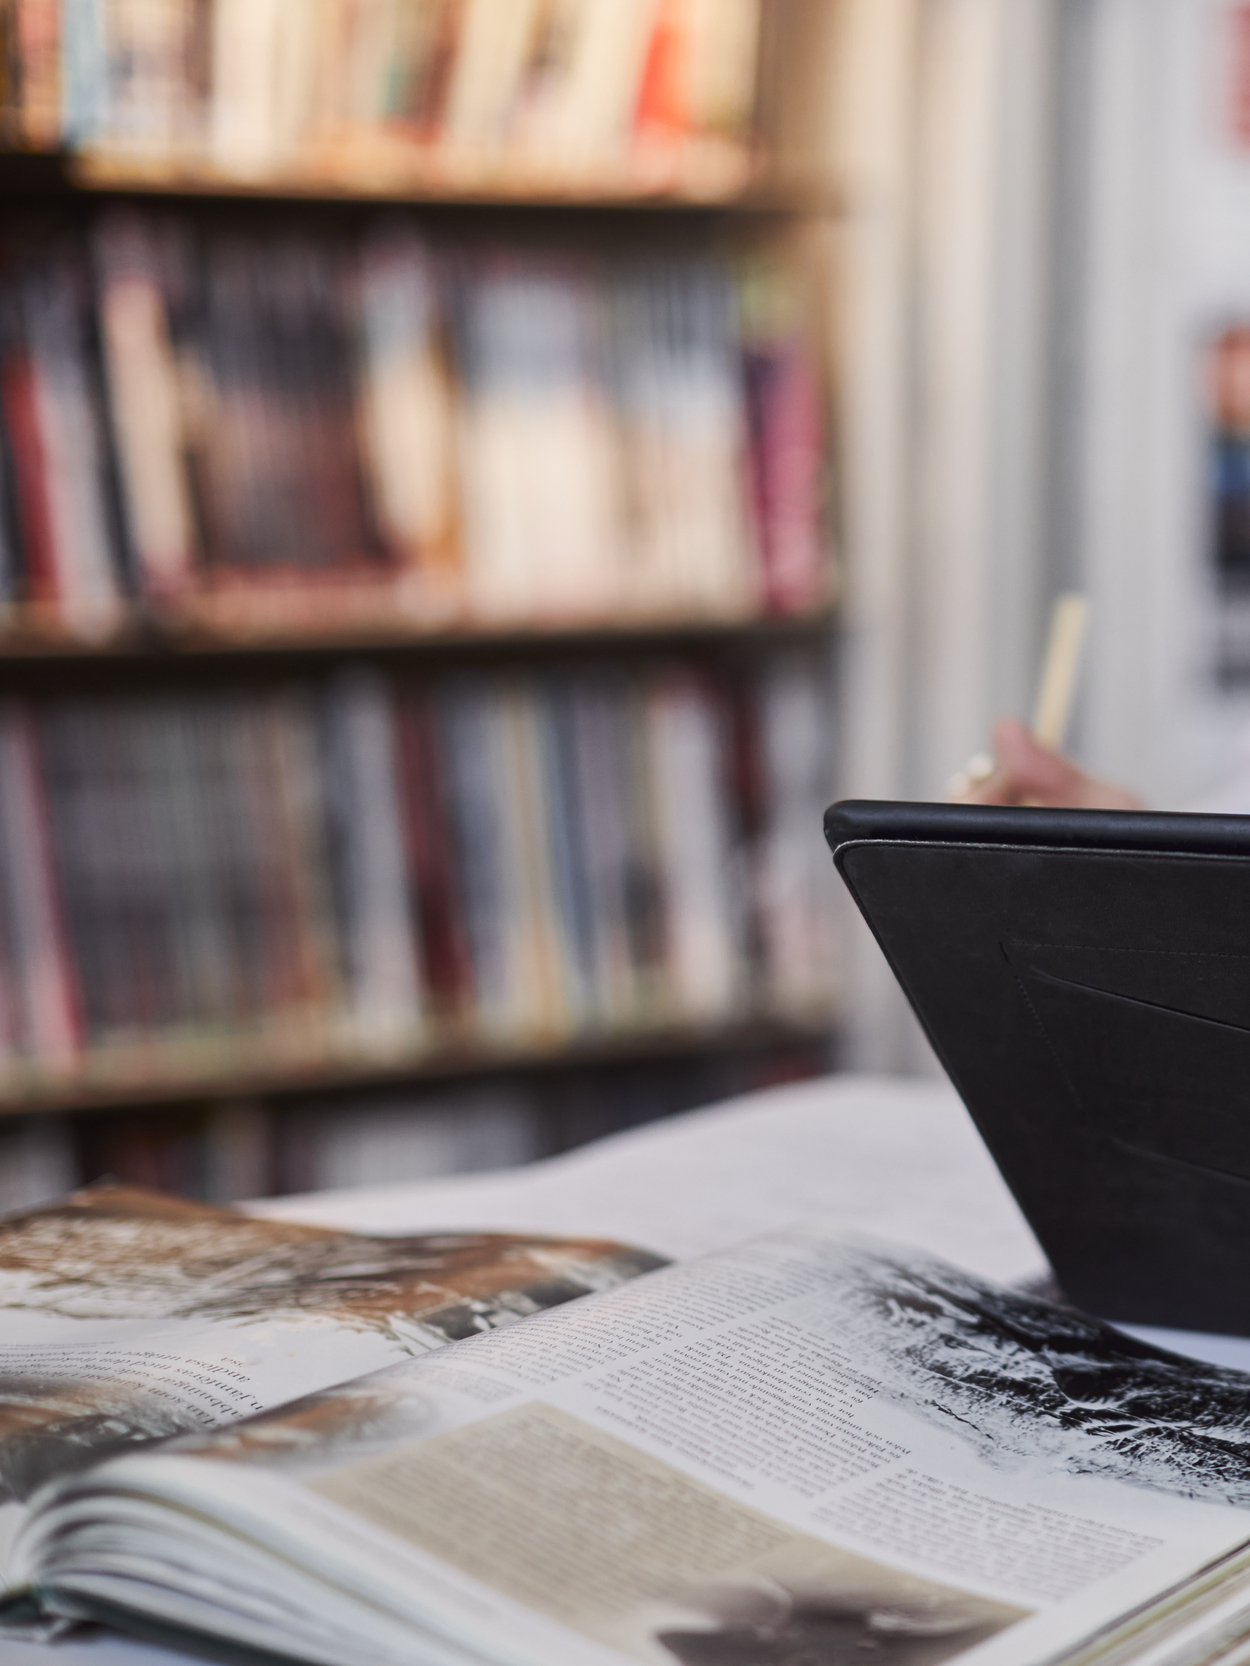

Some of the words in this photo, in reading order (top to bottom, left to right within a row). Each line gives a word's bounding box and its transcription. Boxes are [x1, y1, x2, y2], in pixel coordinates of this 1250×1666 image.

[716, 1333, 731, 1341] var
[727, 1329, 770, 1349] acceptera
[695, 1341, 713, 1351] han
[706, 1337, 736, 1352] styrkor
[731, 1340, 751, 1350] håll
[673, 1348, 701, 1362] erövra
[683, 1345, 710, 1357] direkt
[716, 1350, 731, 1359] Då
[753, 1349, 779, 1362] andra
[129, 1361, 171, 1369] med
[639, 1359, 655, 1368] tog
[662, 1352, 702, 1371] problem
[714, 1358, 733, 1368] eller
[740, 1352, 770, 1367] frigöra
[185, 1359, 250, 1382] ändlösa
[655, 1367, 673, 1376] den
[671, 1365, 690, 1376] från
[716, 1367, 729, 1375] var
[791, 1359, 825, 1376] beredd
[80, 1374, 146, 1390] kämpat
[691, 1374, 723, 1391] tillbaka
[701, 1370, 727, 1383] något
[728, 1374, 748, 1384] mål
[735, 1368, 786, 1393] omedelbart
[738, 1360, 811, 1396] centralmakterna.
[796, 1369, 847, 1395] operationer
[831, 1378, 849, 1387] inte
[173, 1369, 255, 1401] jämföras
[729, 1383, 747, 1393] inte
[789, 1375, 835, 1398] angelägen
[147, 1387, 185, 1404] som
[724, 1389, 737, 1397] sig
[748, 1392, 771, 1405] dock
[850, 1395, 863, 1403] för
[855, 1388, 873, 1399] han
[738, 1396, 765, 1411] dragit
[749, 1384, 815, 1416] grundläggande
[789, 1394, 811, 1406] varje
[815, 1397, 834, 1407] mot
[839, 1399, 852, 1407] var
[733, 1404, 747, 1413] var
[773, 1405, 808, 1424] innebar
[838, 1408, 854, 1418] hot
[748, 1411, 764, 1420] det
[766, 1411, 788, 1424] hade
[815, 1406, 862, 1430] undanröja
[815, 1416, 833, 1427] vars
[764, 1419, 782, 1430] och
[810, 1423, 836, 1438] Detta
[789, 1422, 827, 1443] ryssarna
[864, 1430, 882, 1440] och
[828, 1441, 855, 1457] innan
[841, 1438, 867, 1453] Polen.
[885, 1440, 911, 1454] Polen
[869, 1451, 891, 1463] trala
[888, 1451, 901, 1459] för
[850, 1461, 869, 1473] föra
[856, 1455, 880, 1469] Brest
